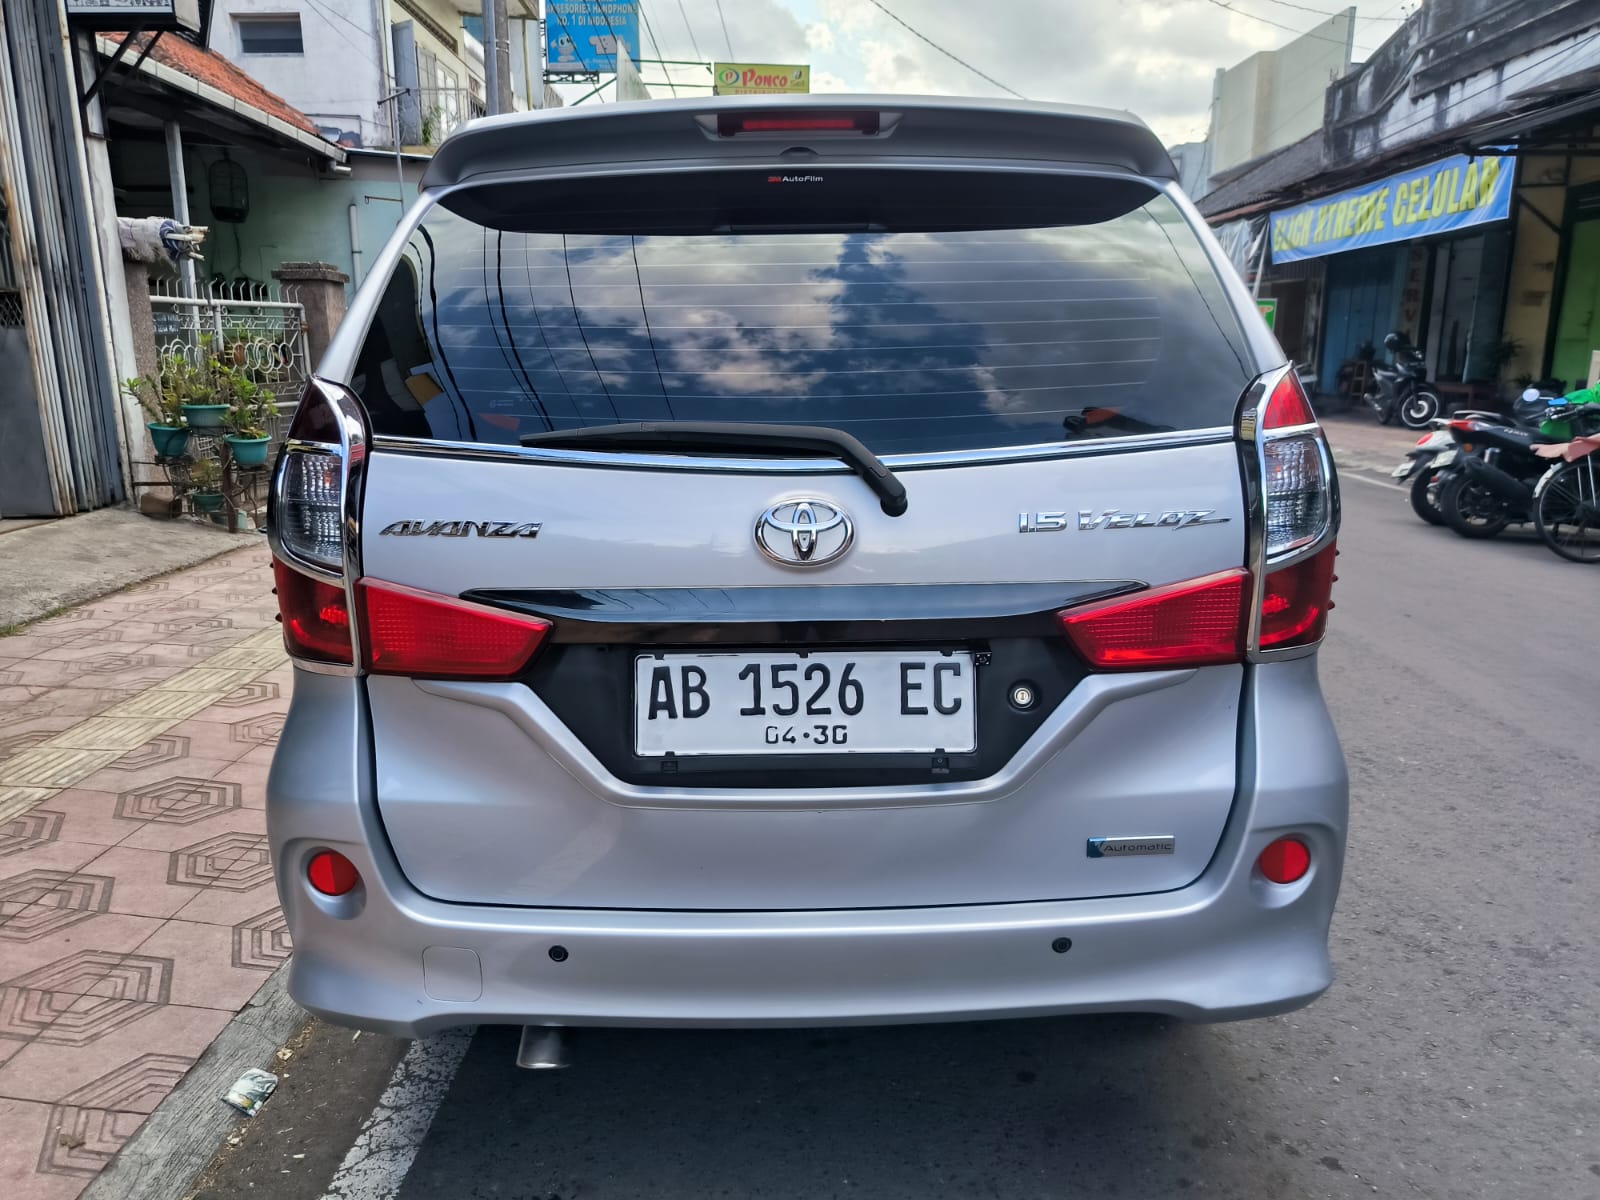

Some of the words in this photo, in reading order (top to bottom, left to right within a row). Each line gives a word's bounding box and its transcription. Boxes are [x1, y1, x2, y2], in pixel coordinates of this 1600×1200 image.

[1393, 156, 1500, 227] CELULAR
[378, 519, 543, 539] AVANZA
[647, 664, 711, 721] AB
[738, 662, 864, 717] 1526
[899, 662, 962, 716] EC
[1103, 843, 1173, 853] Automatic
